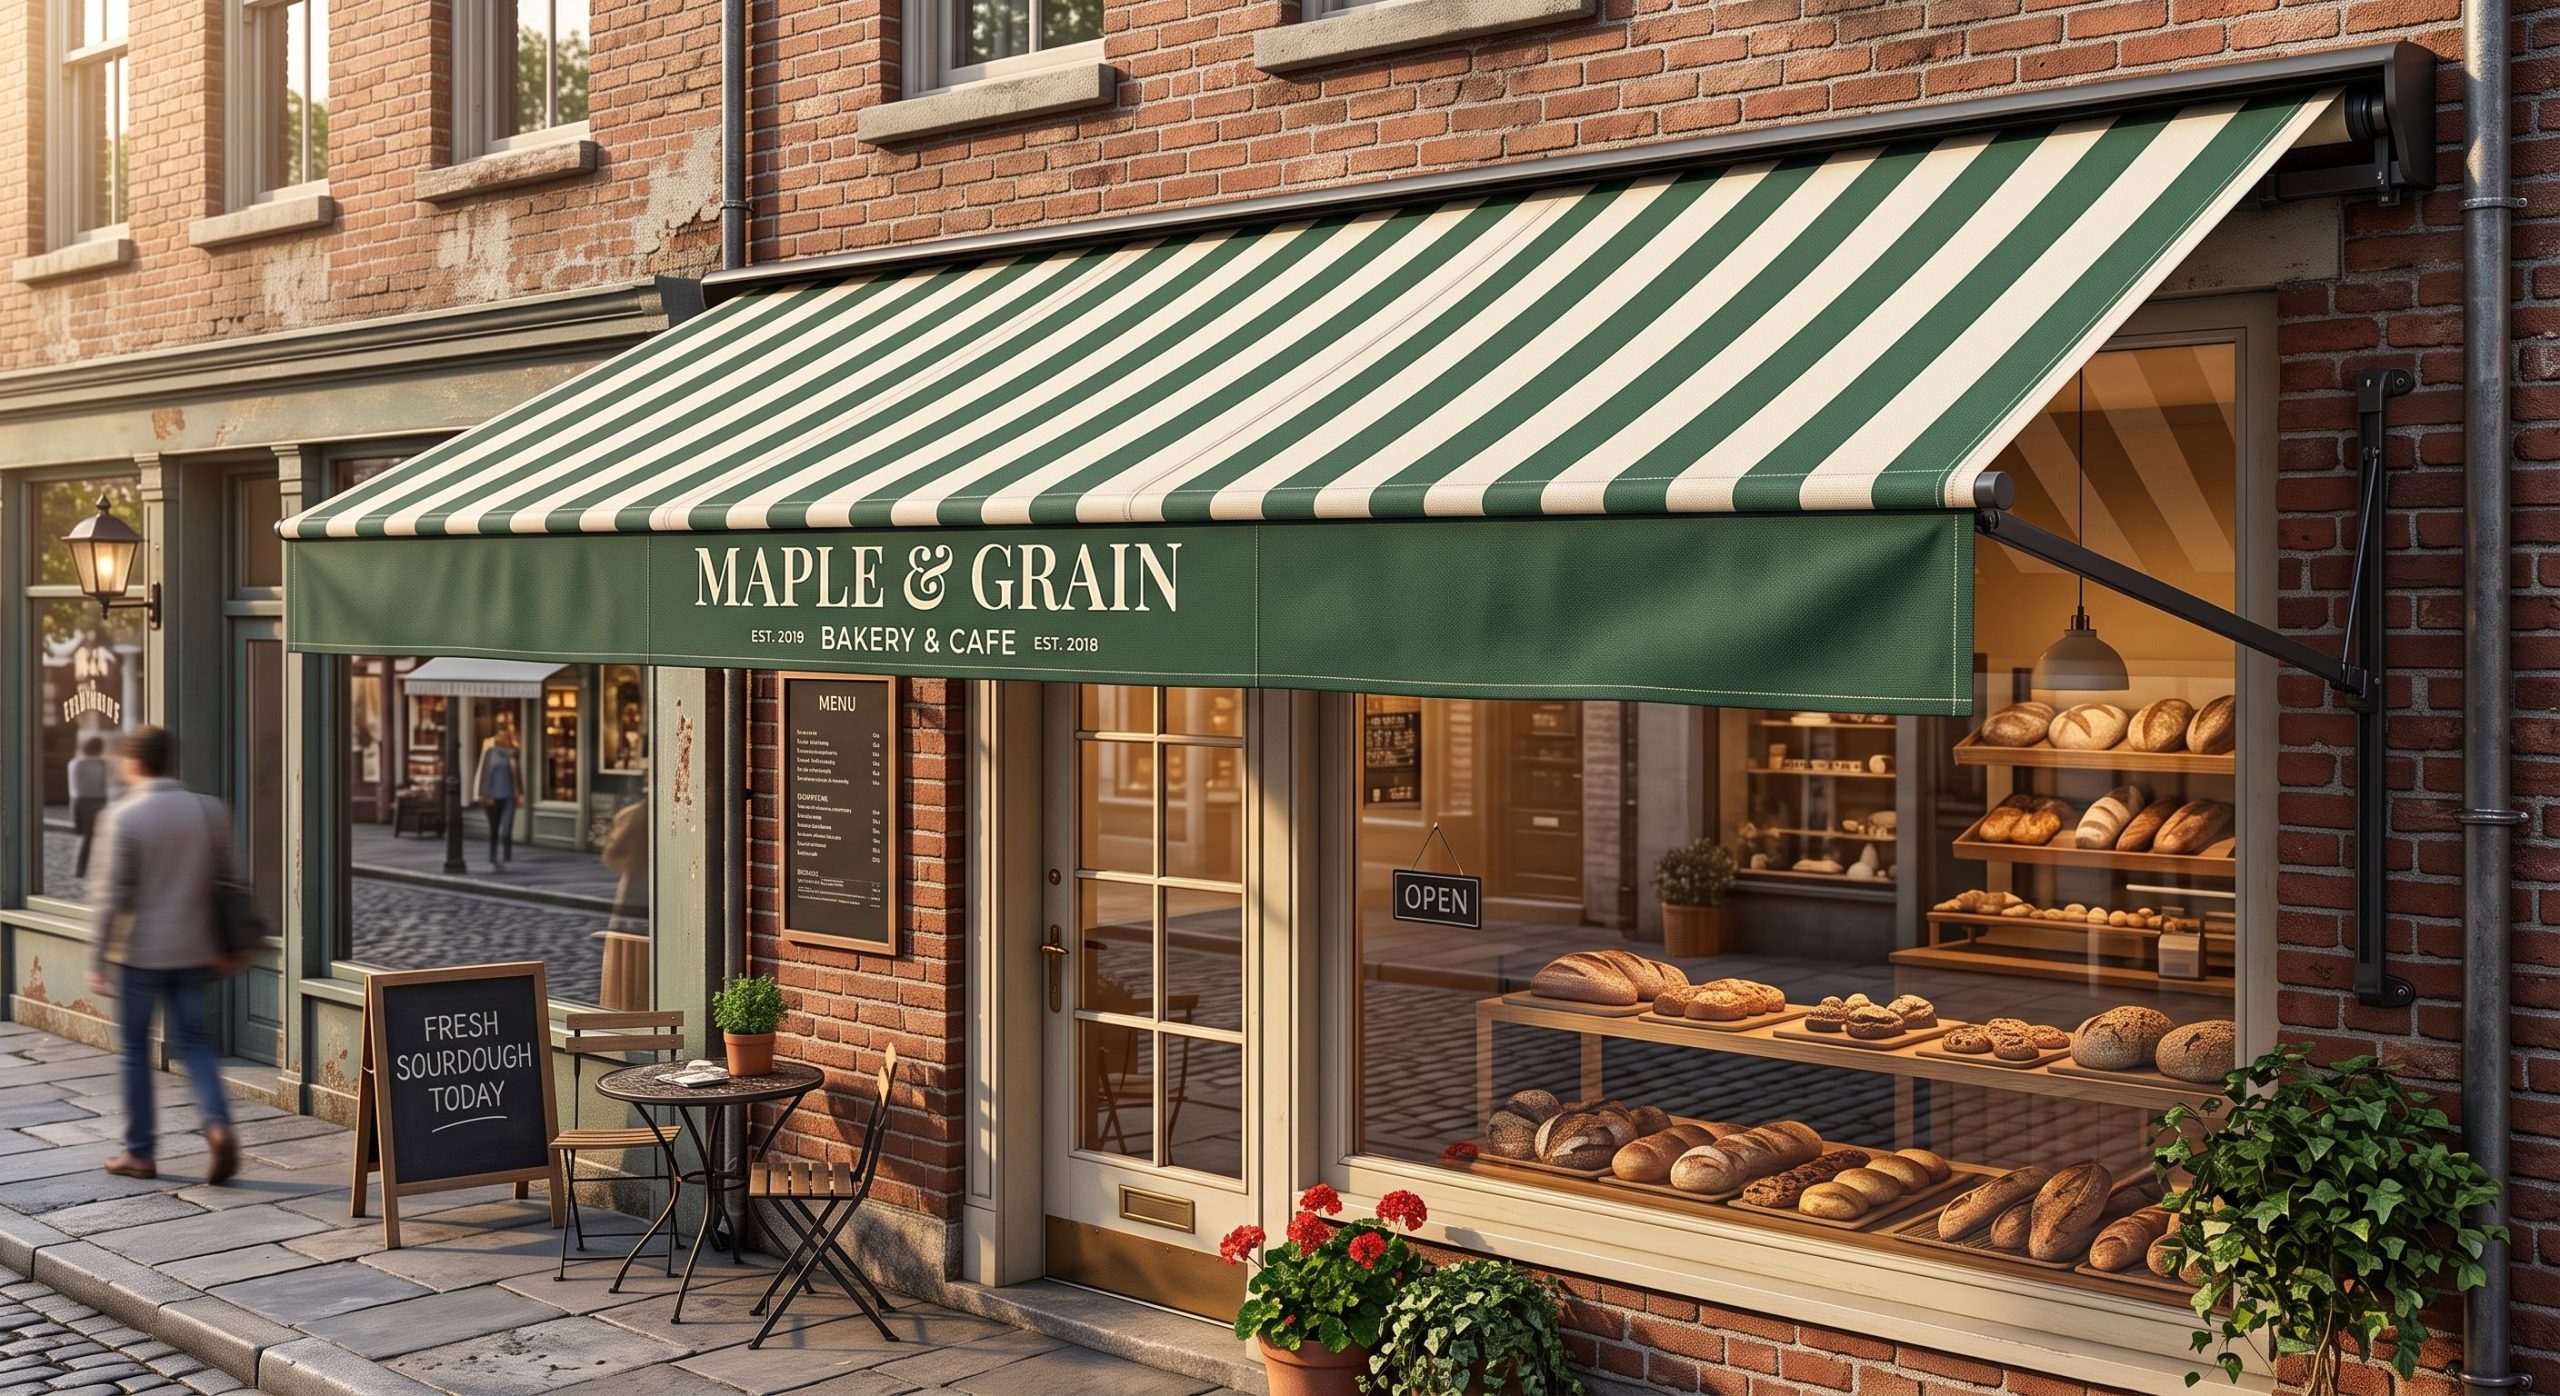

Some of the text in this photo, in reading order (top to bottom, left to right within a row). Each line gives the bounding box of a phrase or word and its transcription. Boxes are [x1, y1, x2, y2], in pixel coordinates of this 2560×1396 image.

[694, 542, 1183, 612] MAPLE & GRAIN
[751, 625, 1099, 655] EST. 2019 BAKERY & CAFE EST. 2018
[819, 695, 856, 712] MENU
[1405, 884, 1467, 915] OPEN
[424, 1010, 499, 1042] FRESH
[396, 1042, 532, 1081] SOURDOUGH
[428, 1080, 505, 1113] TODAY
